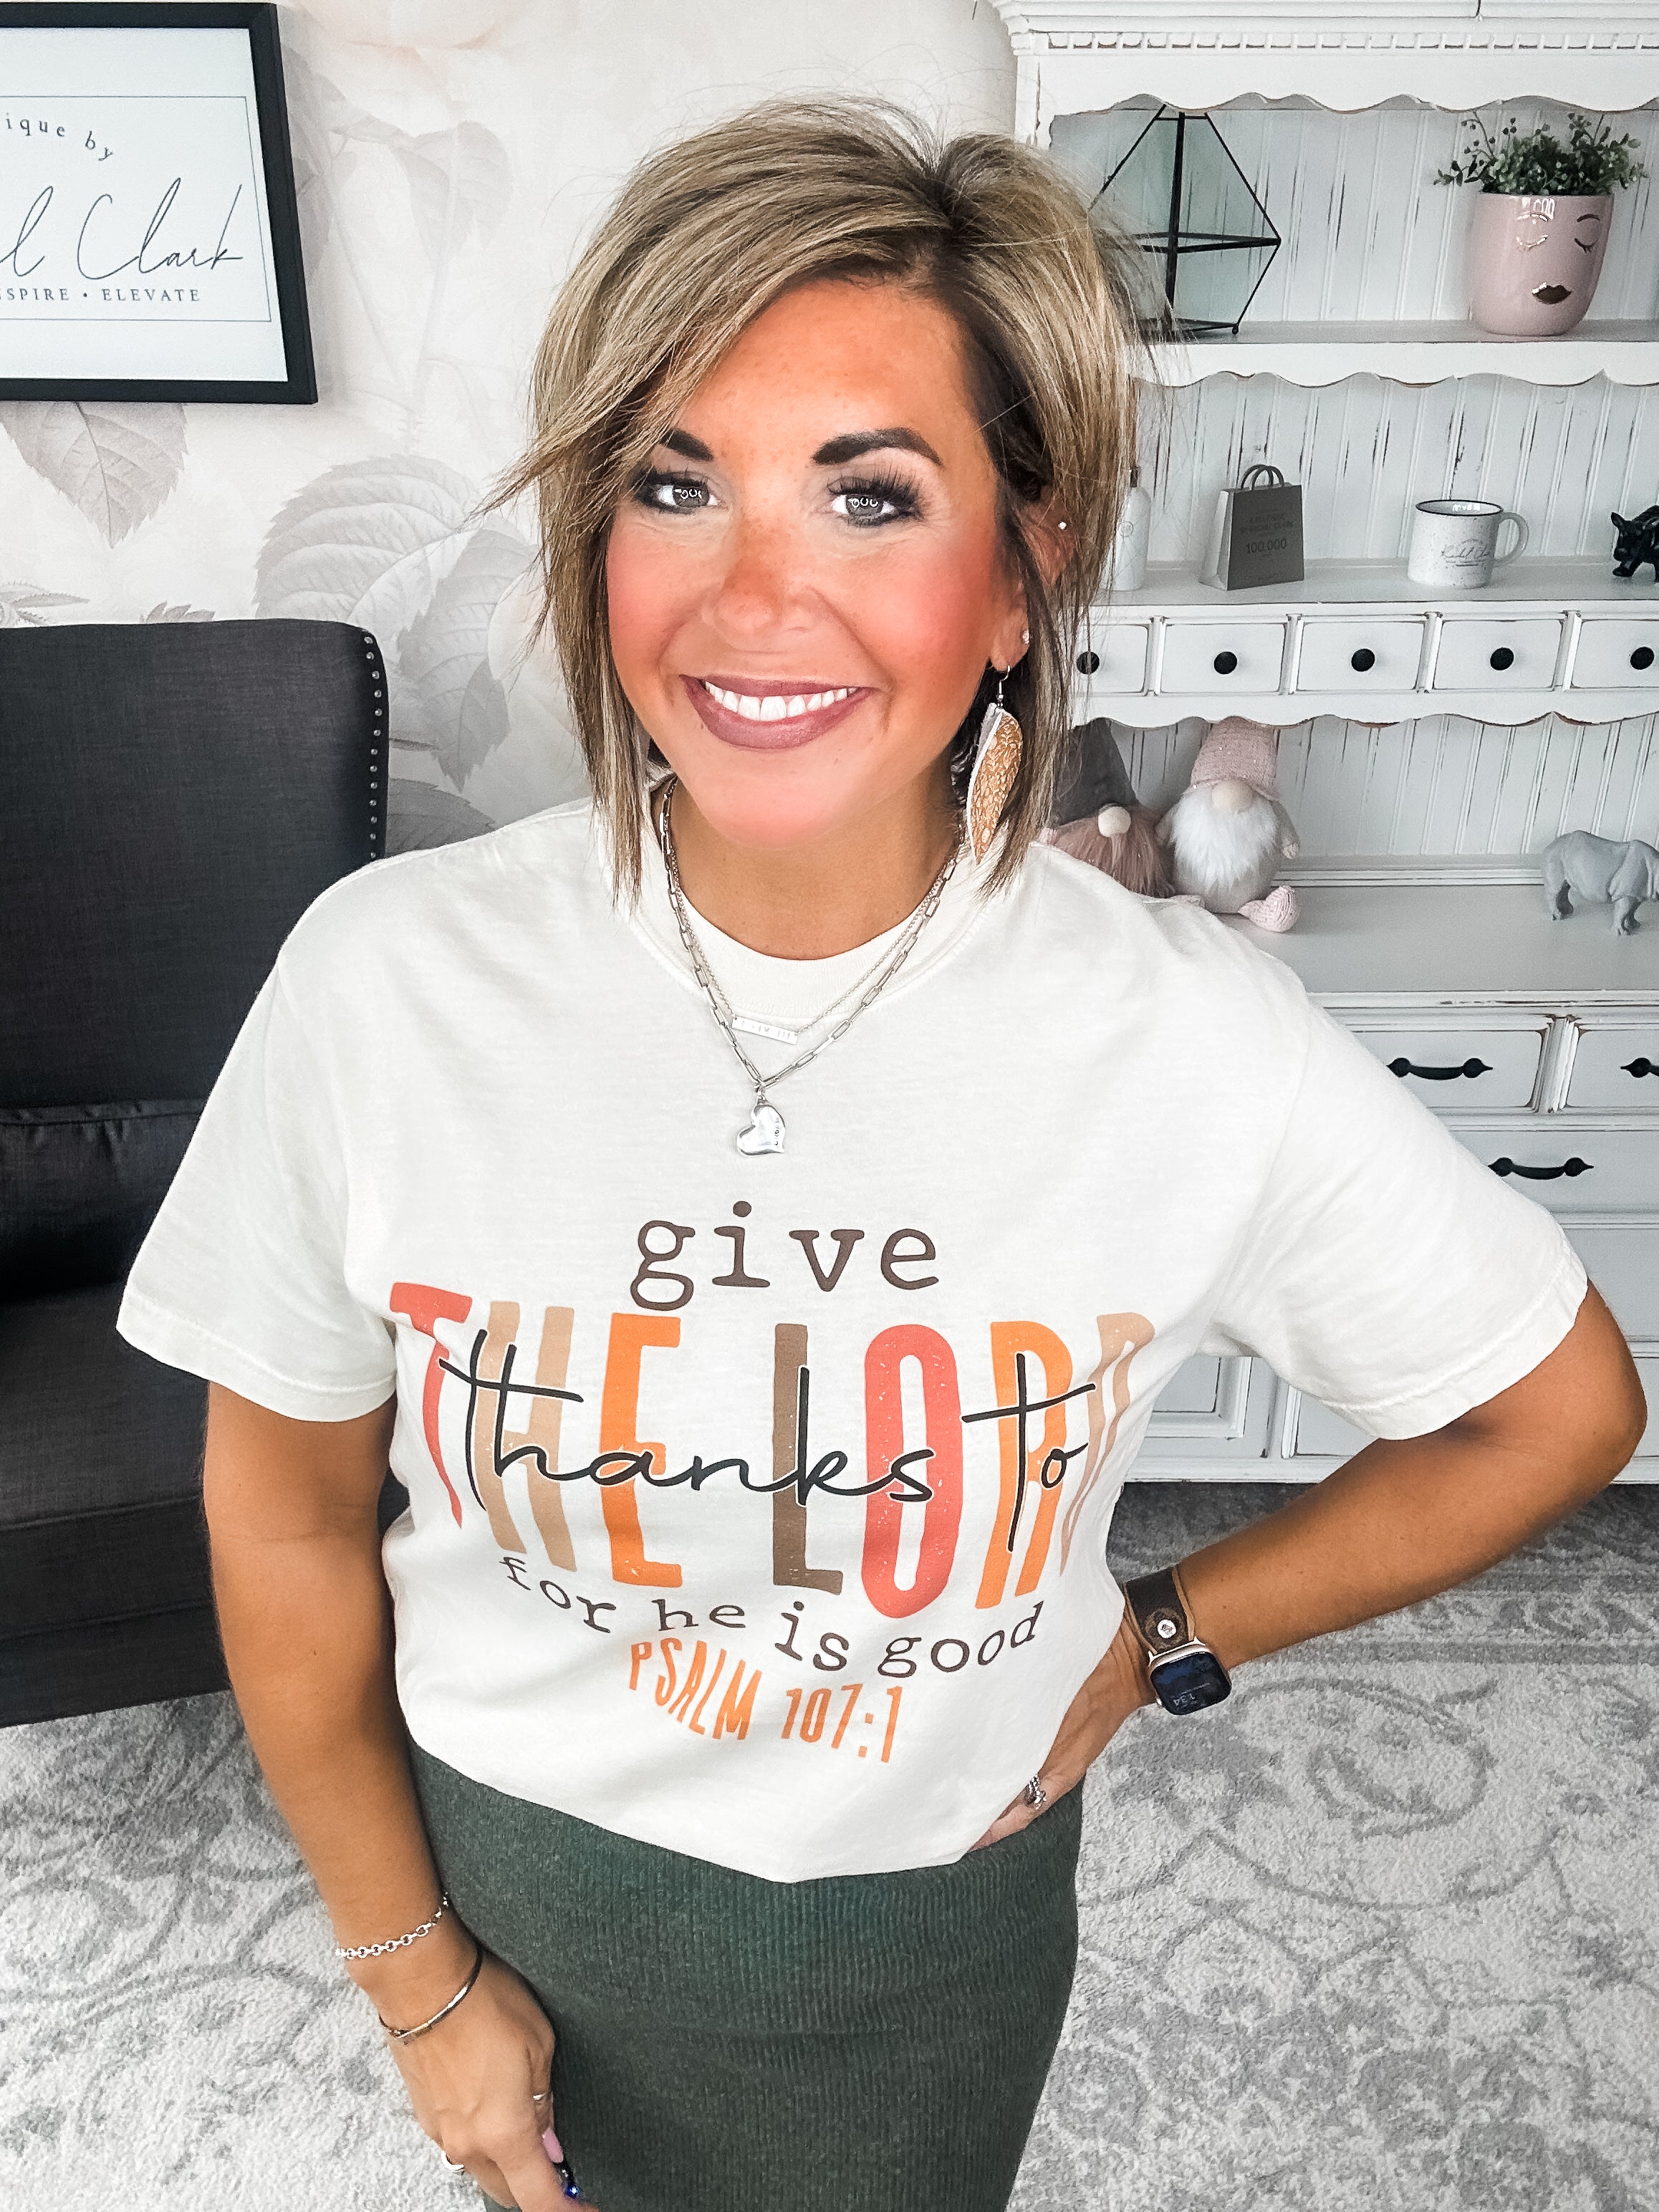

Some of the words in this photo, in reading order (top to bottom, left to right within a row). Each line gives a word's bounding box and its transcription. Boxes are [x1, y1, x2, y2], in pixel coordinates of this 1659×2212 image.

[85, 131, 114, 162] by
[77, 177, 244, 280] Clark
[0, 288, 69, 301] SPIRE
[102, 289, 201, 302] ELEVATE
[630, 1201, 939, 1311] give
[390, 1281, 683, 1588] THE
[772, 1312, 1155, 1619] LORD
[438, 1329, 935, 1511] thanks
[961, 1353, 1096, 1552] to
[499, 1557, 617, 1634] for
[652, 1598, 746, 1631] he
[774, 1601, 850, 1672] is
[877, 1601, 1044, 1678] good
[630, 1637, 762, 1741] PSALM
[782, 1683, 903, 1764] 107:1
